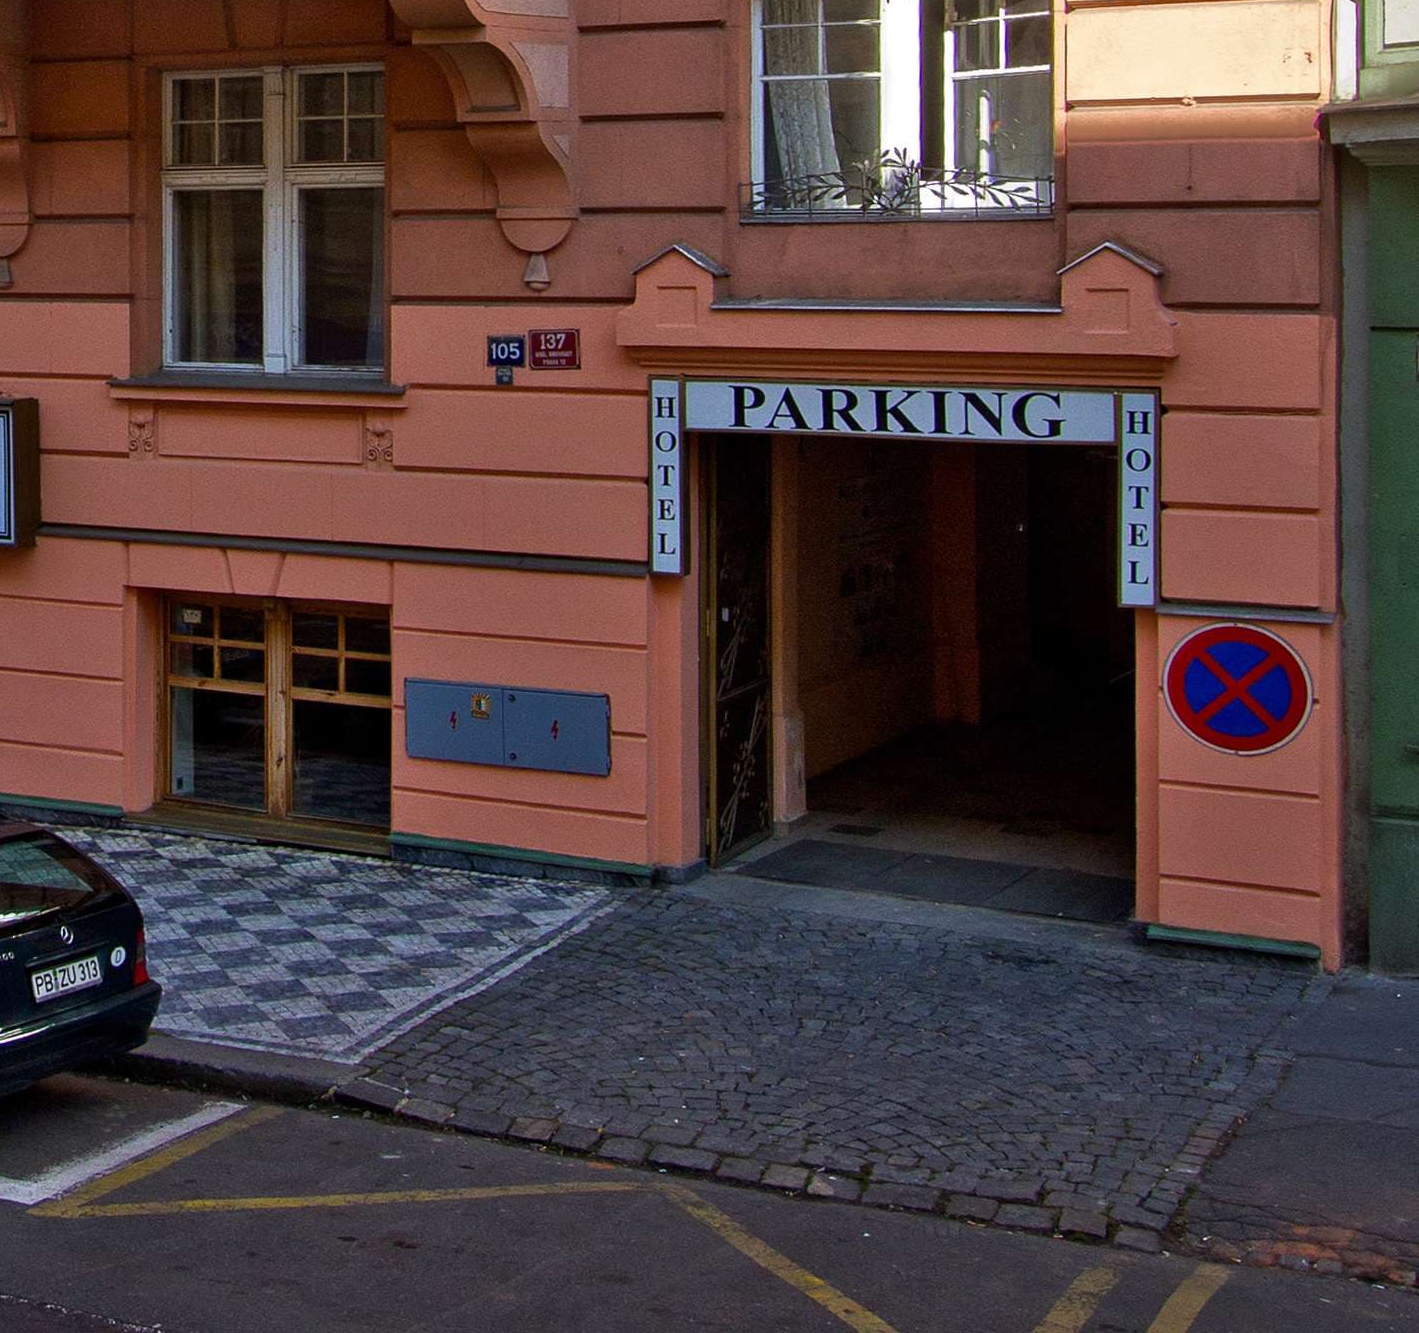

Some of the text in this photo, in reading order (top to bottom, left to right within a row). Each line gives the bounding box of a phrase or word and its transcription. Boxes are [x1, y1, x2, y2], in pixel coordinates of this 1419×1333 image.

[491, 343, 520, 360] 105
[540, 333, 566, 350] 137
[728, 384, 1066, 439] PARKING
[654, 396, 678, 556] HOTEL
[1125, 410, 1152, 586] HOTEL
[35, 959, 99, 995] PB ZU 313
